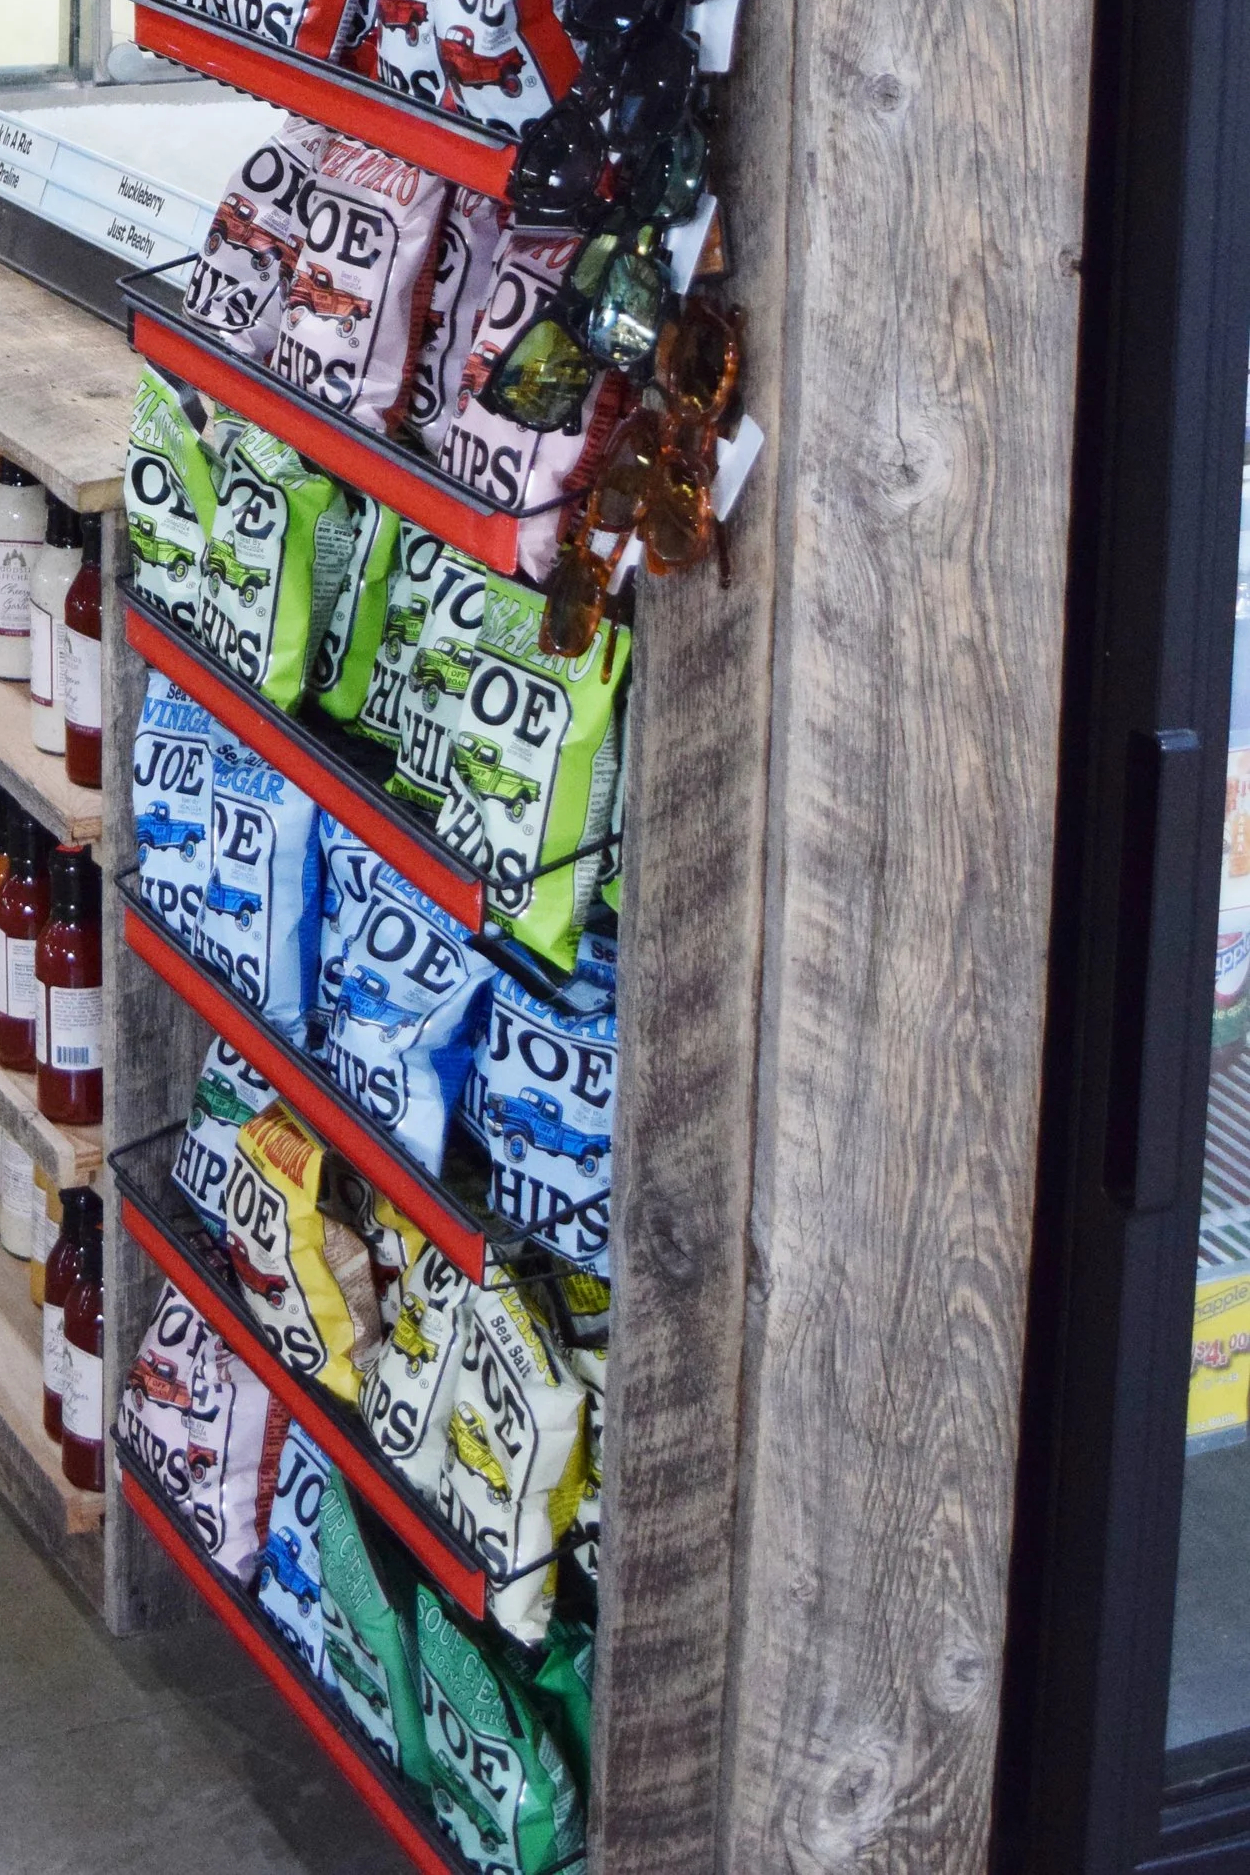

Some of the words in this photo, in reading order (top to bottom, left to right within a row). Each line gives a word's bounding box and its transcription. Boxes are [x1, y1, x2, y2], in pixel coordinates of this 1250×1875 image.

[2, 124, 11, 147] In
[9, 130, 20, 150] A
[17, 133, 33, 155] Rut
[117, 175, 165, 217] Huckleberry
[306, 198, 384, 270] OE
[106, 219, 127, 241] Just
[126, 225, 156, 259] Peachy
[185, 258, 258, 327] HIPS
[275, 332, 356, 412] HIPS
[439, 424, 523, 509] HIPS
[431, 565, 487, 630] JO
[198, 596, 263, 687] HIPS
[470, 664, 557, 749] OE
[134, 740, 205, 796] JOE
[352, 894, 461, 995] JOE
[327, 1043, 401, 1127] HIPS
[490, 1008, 613, 1109] JOE
[175, 1131, 228, 1210] HIP
[225, 1156, 283, 1253] JOE
[491, 1158, 611, 1255] HIPS
[490, 1315, 512, 1347] Sea
[507, 1344, 534, 1380] Salt
[461, 1320, 525, 1460] JOE
[119, 1412, 191, 1498] HIPS
[273, 1450, 326, 1528] JO
[319, 1486, 348, 1537] OUR
[421, 1670, 510, 1804] JOE
